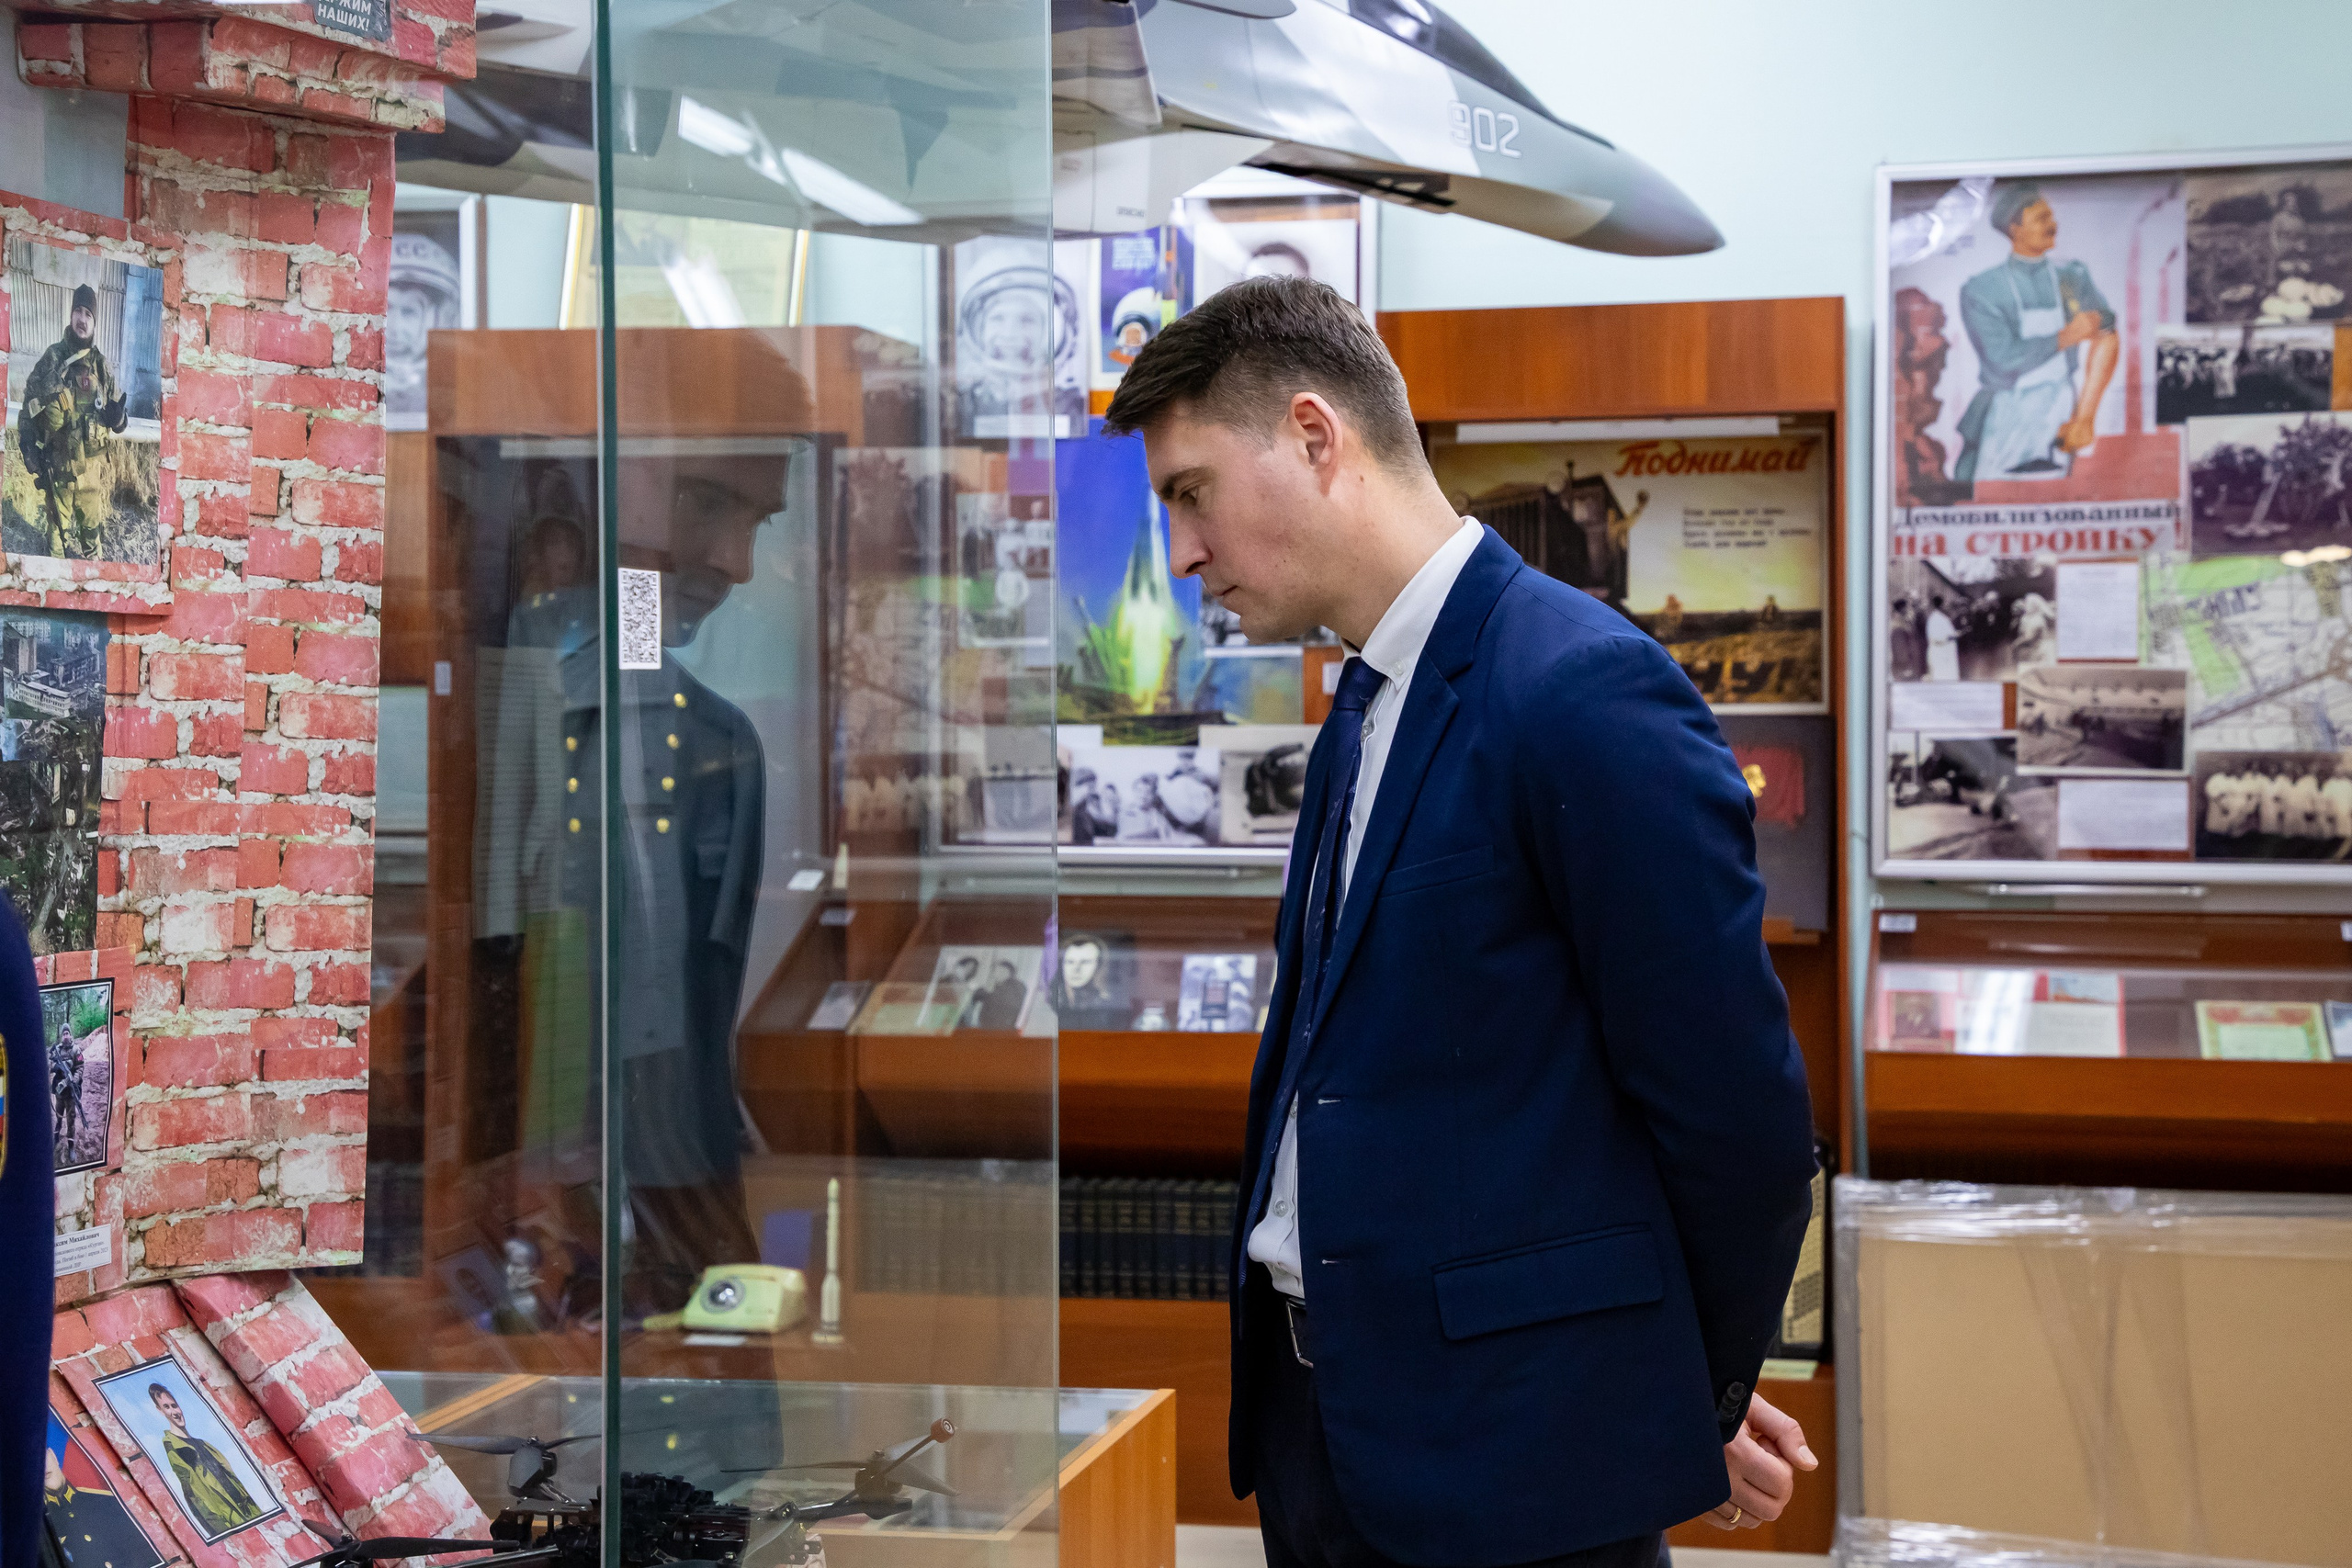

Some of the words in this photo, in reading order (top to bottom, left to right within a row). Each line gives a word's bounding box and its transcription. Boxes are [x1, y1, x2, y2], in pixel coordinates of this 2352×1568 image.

[318, 3, 369, 31] НАШИХ!
[1447, 100, 1521, 158] 902
[1614, 436, 1821, 479] Поднимай
[1894, 534, 1947, 556] на
[55, 1239, 68, 1247] ксим
[69, 1232, 100, 1244] Михайлович
